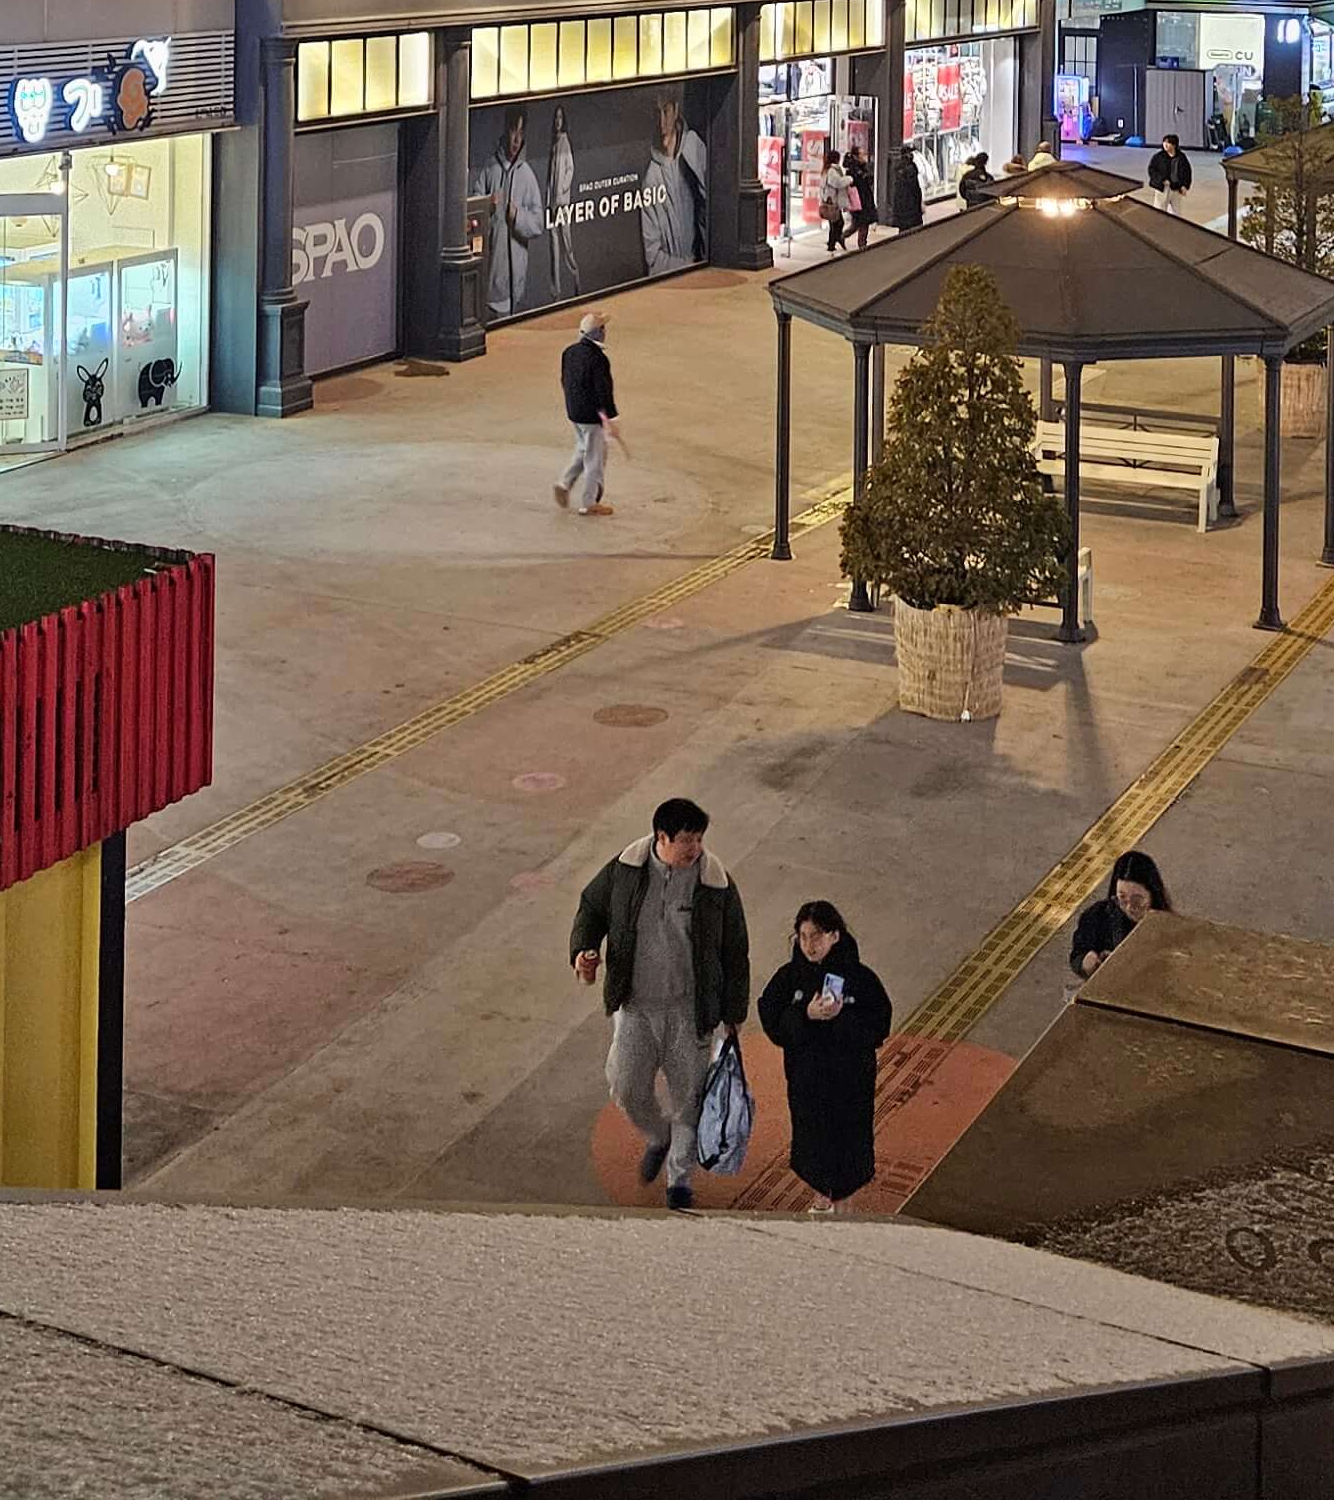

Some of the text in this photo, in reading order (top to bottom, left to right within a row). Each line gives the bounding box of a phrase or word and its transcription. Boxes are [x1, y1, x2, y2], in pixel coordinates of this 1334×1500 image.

[1234, 51, 1254, 61] CU
[546, 184, 668, 229] LAYER OF BASIC
[291, 213, 385, 286] SPAO
